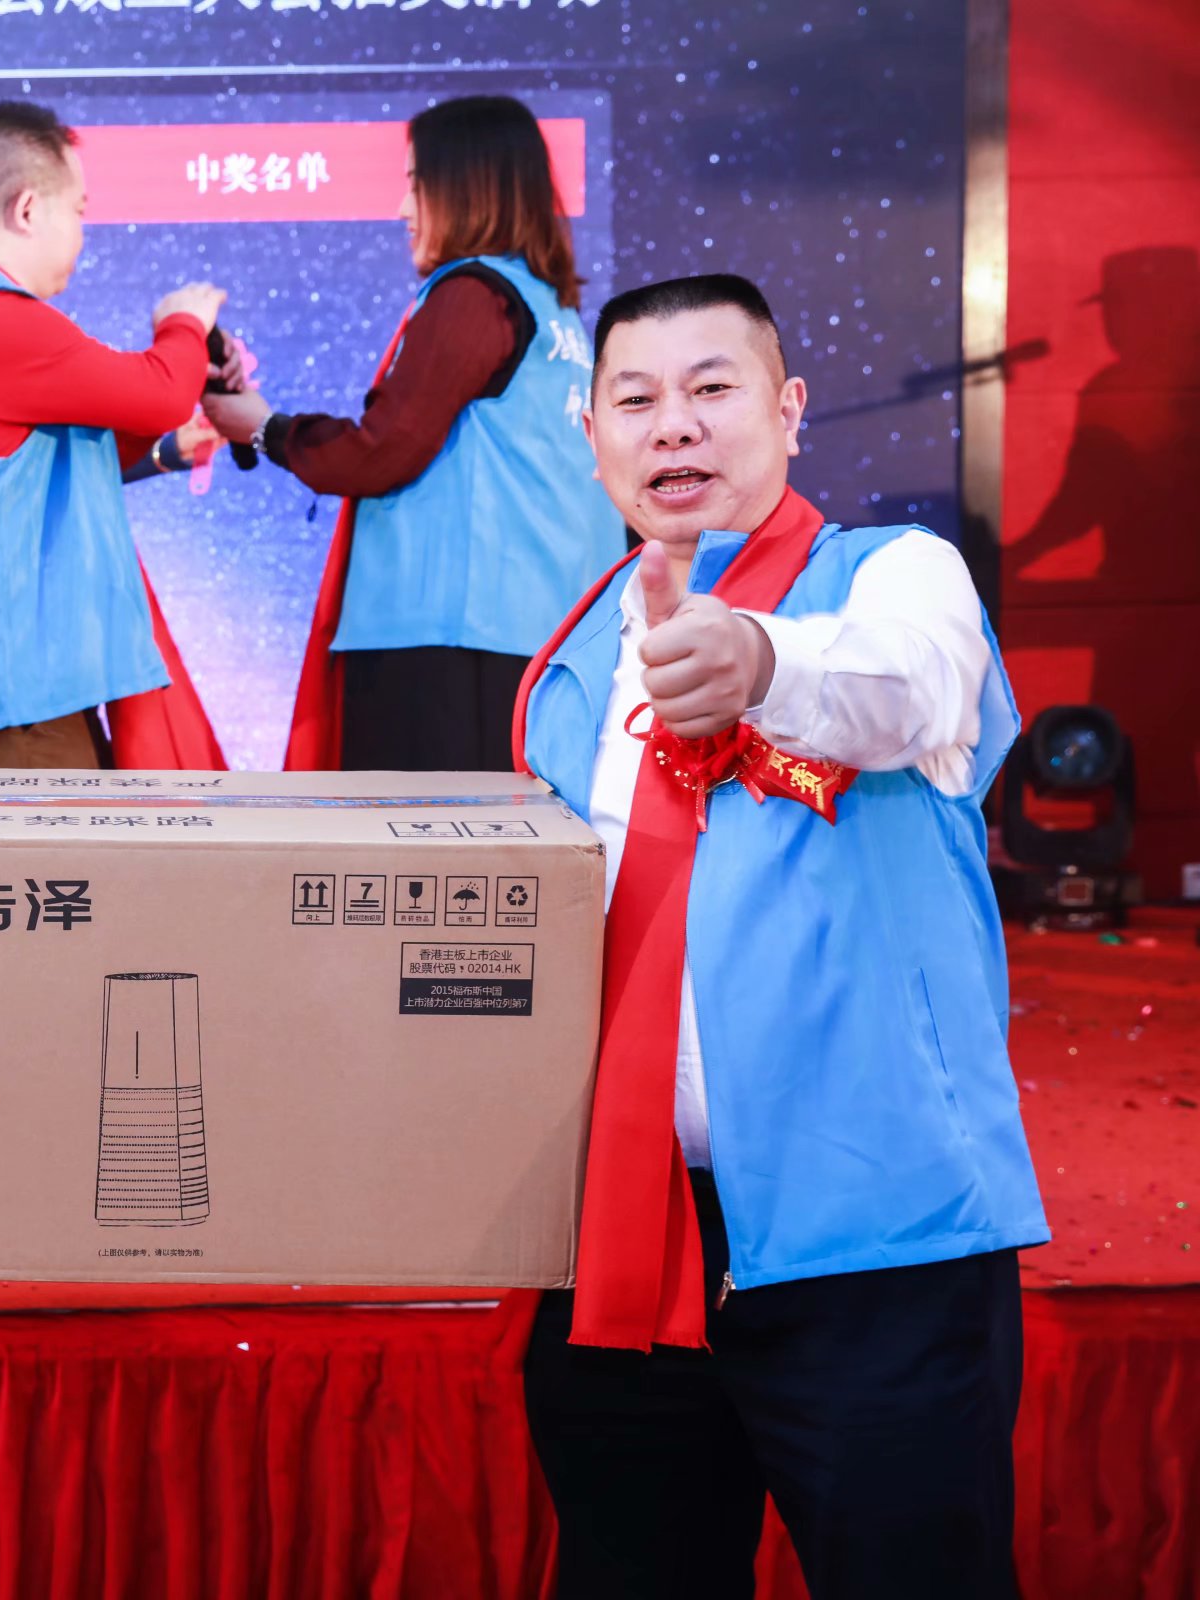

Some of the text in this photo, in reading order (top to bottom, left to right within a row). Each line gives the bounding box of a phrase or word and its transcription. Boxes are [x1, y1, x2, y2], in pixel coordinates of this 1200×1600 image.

[186, 151, 331, 194] 中奖名单
[361, 883, 374, 899] 7
[419, 948, 513, 961] 香港主板上市企业
[430, 985, 503, 997] 2015福布斯中国
